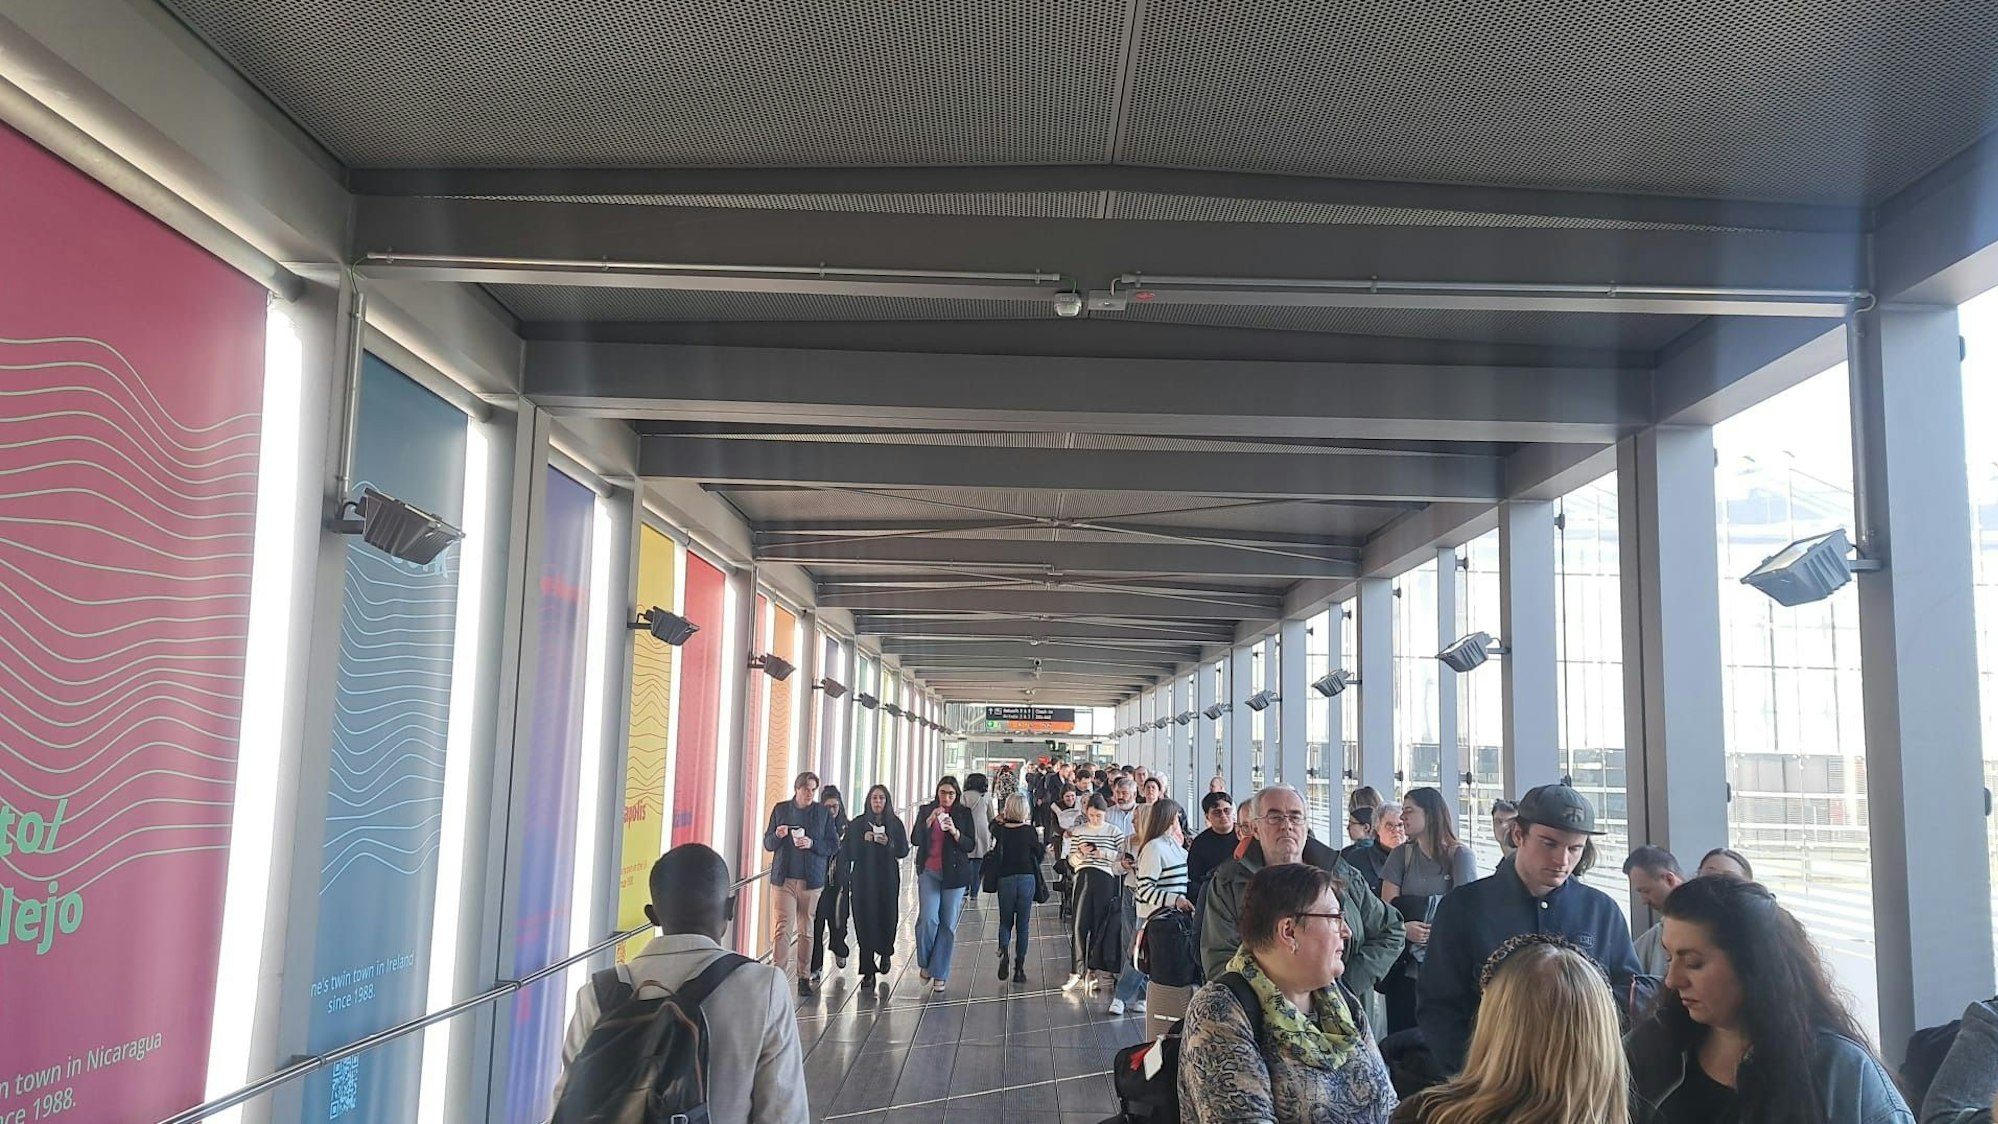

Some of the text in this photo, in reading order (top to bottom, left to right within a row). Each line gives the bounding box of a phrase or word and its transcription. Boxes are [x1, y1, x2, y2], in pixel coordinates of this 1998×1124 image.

[0, 881, 84, 956] lejo
[310, 950, 415, 998] ne's twin town in Ireland
[327, 983, 376, 1014] since 1988.
[15, 1064, 61, 1095] town
[66, 1056, 82, 1079] in
[86, 1031, 163, 1073] Nicaragua
[33, 1087, 76, 1121] 1988.
